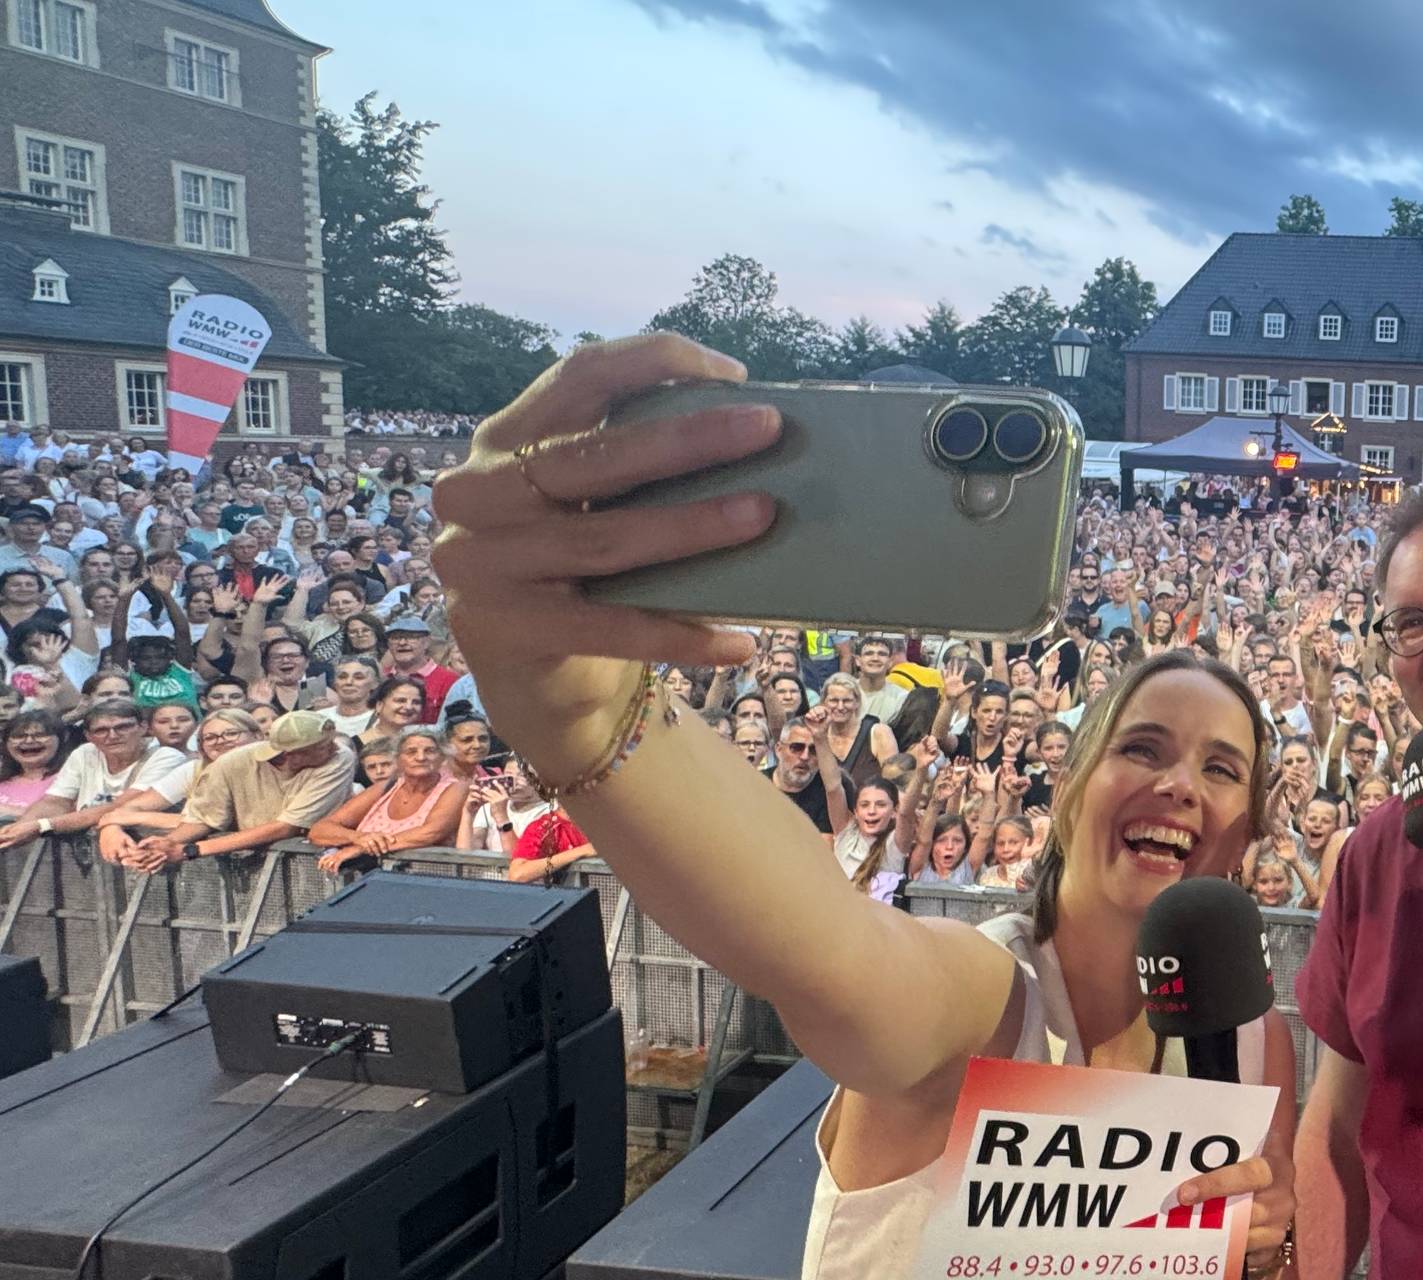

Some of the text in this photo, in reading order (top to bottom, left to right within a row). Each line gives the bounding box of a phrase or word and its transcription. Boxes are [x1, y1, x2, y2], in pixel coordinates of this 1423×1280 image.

[188, 319, 231, 338] WMW
[191, 310, 264, 340] RADIO
[1136, 955, 1180, 974] DIO
[976, 1119, 1241, 1173] RADIO
[966, 1181, 1128, 1228] WMW
[947, 1254, 1218, 1277] 88.4 93.0 97.6 103.6
